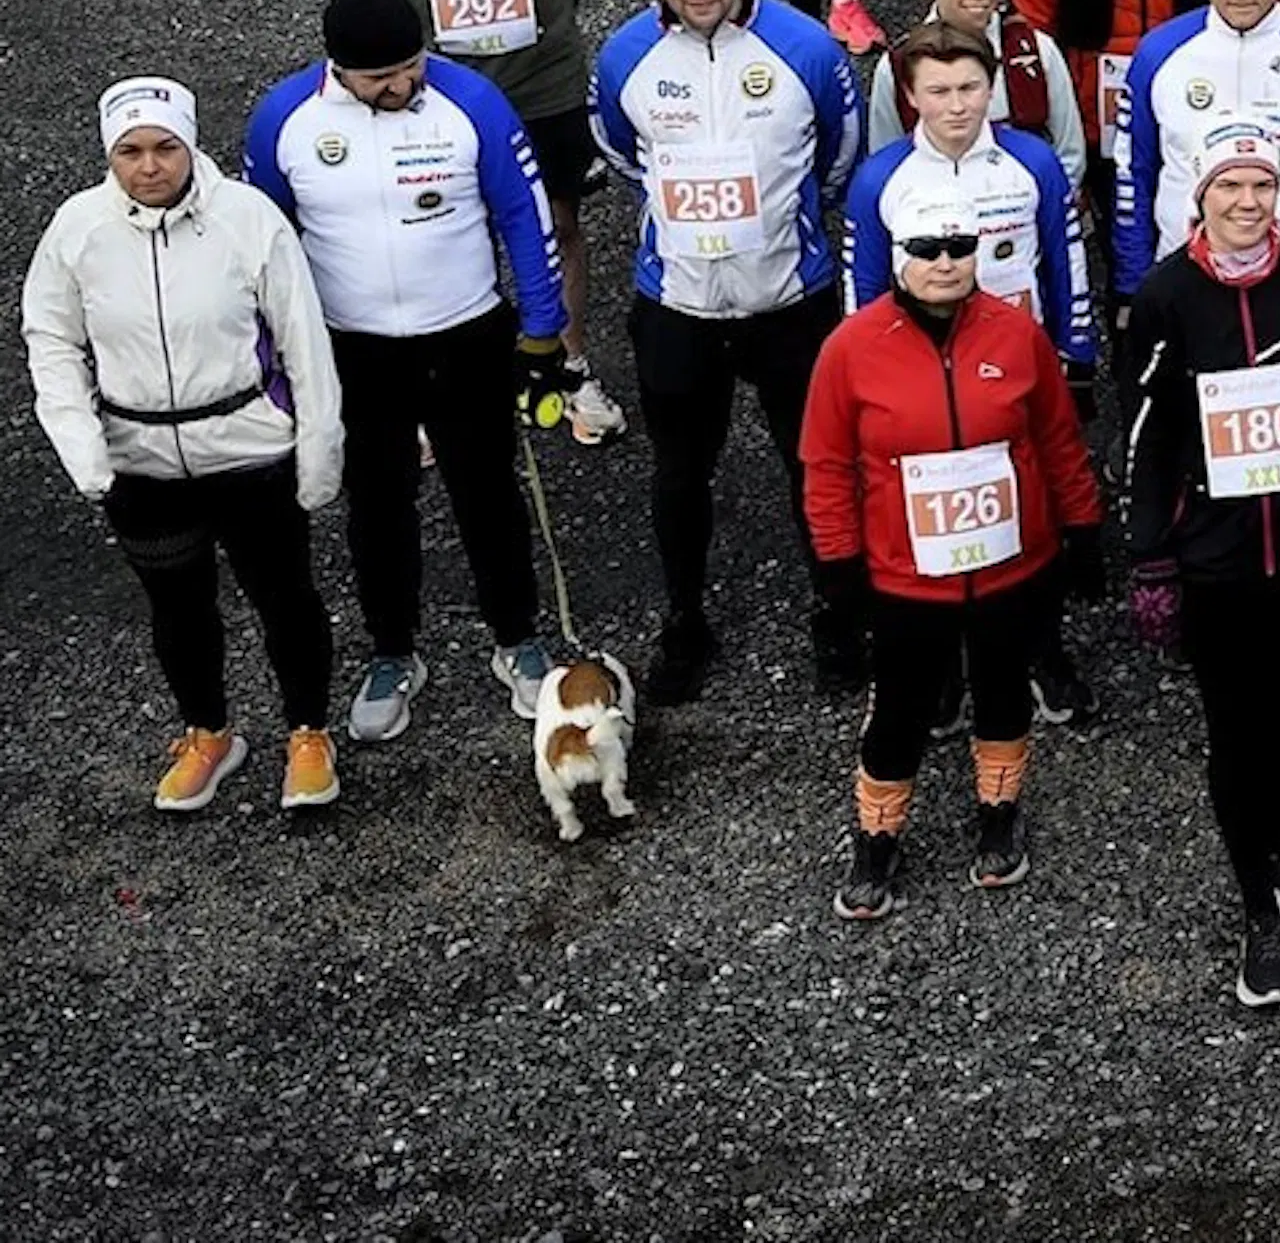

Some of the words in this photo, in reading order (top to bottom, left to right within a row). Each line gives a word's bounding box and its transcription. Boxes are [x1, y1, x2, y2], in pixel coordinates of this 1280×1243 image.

[470, 34, 504, 52] XXL
[675, 181, 744, 221] 258
[698, 234, 731, 253] XXL
[927, 484, 1000, 534] 126
[951, 545, 987, 566] XXL
